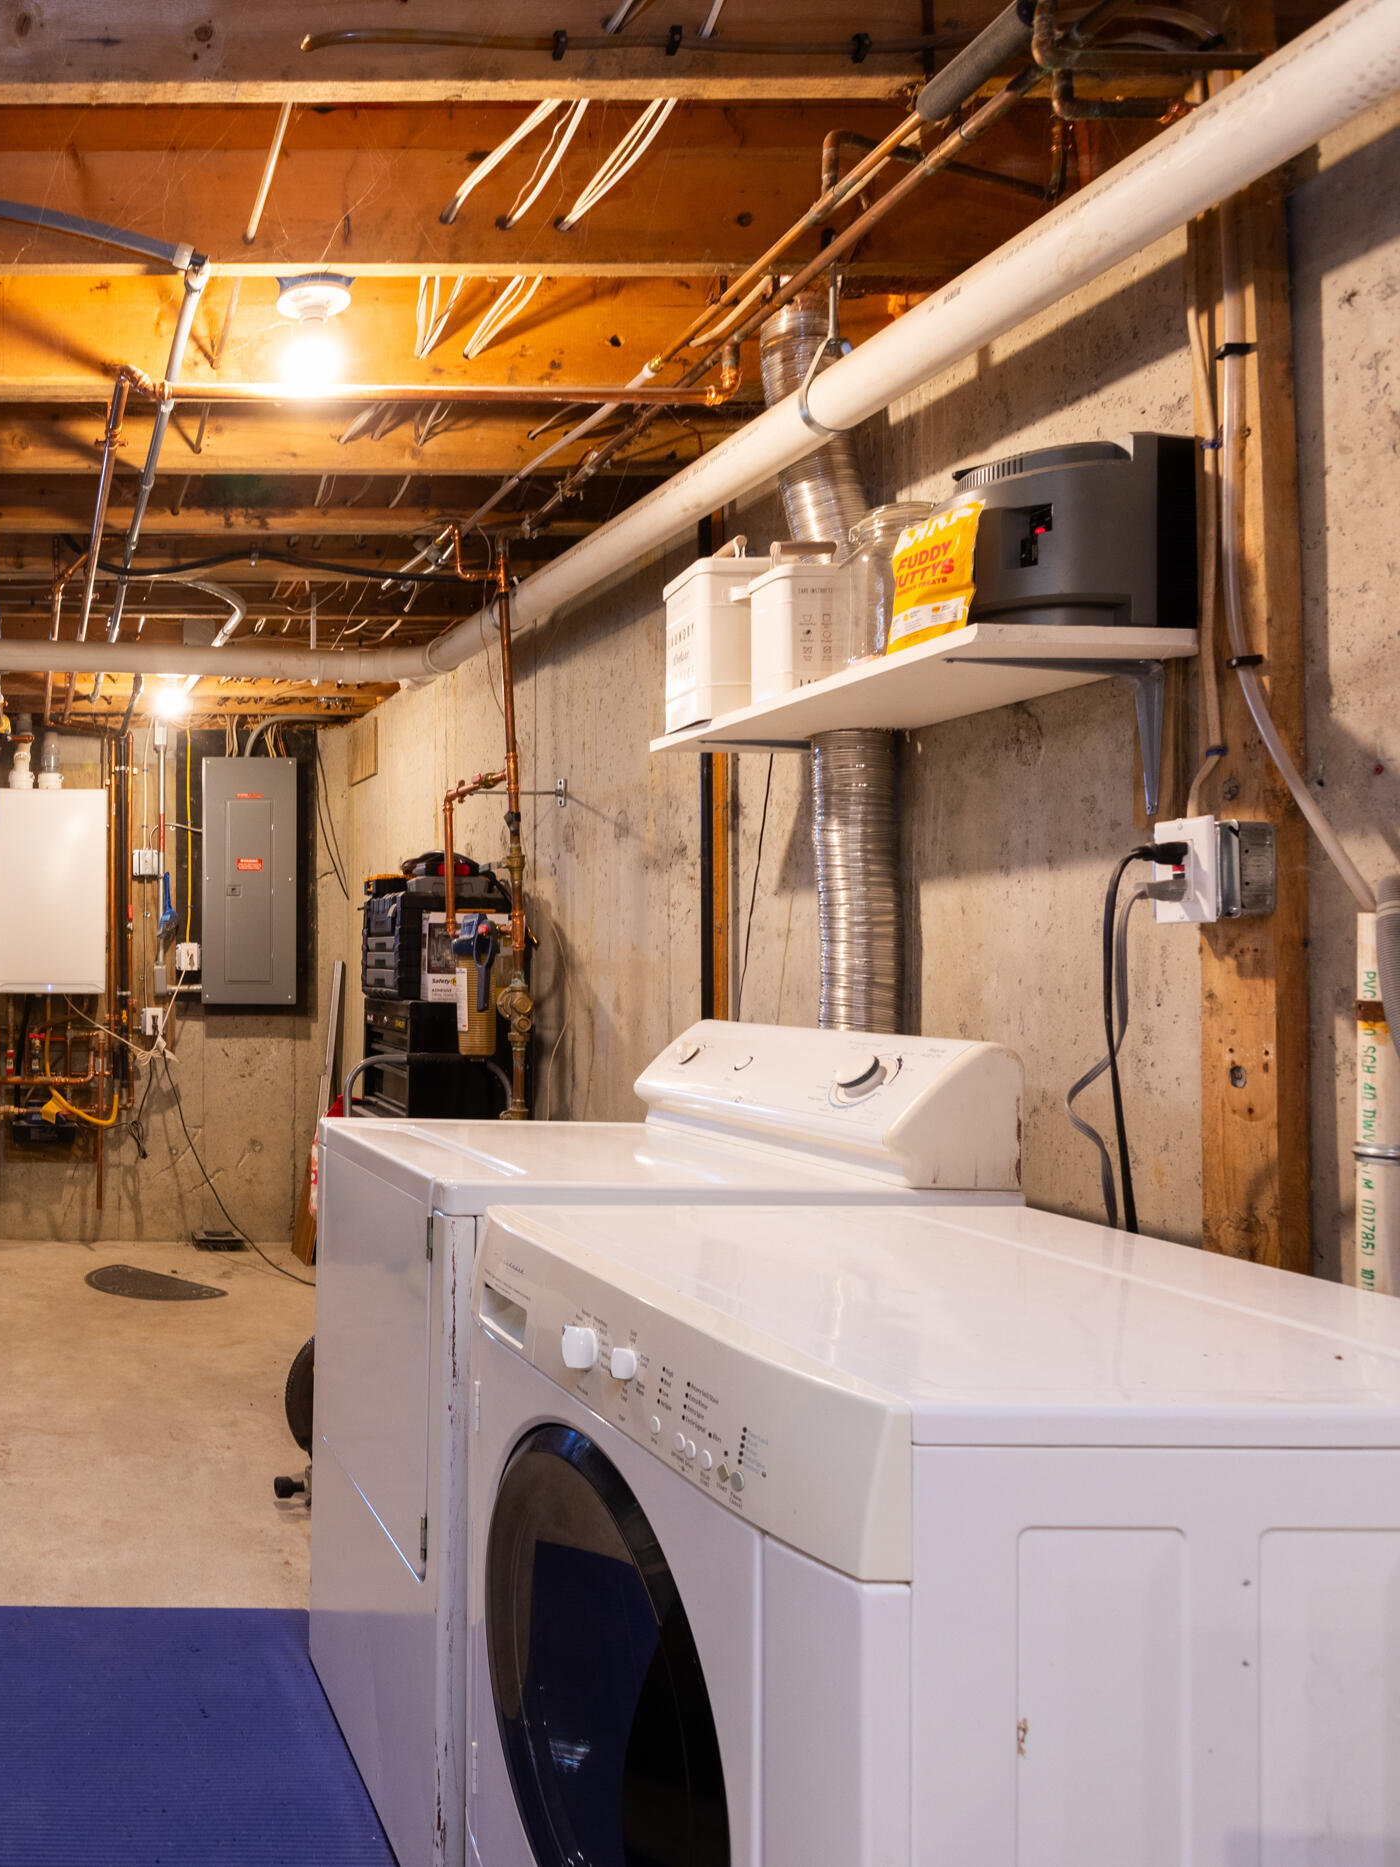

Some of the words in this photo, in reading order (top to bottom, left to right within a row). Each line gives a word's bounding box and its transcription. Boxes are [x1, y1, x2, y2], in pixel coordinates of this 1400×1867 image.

[897, 540, 953, 573] FUDDY
[1362, 970, 1377, 999] PVC
[1362, 1045, 1377, 1075] SCH
[1362, 1108, 1377, 1143] DWV
